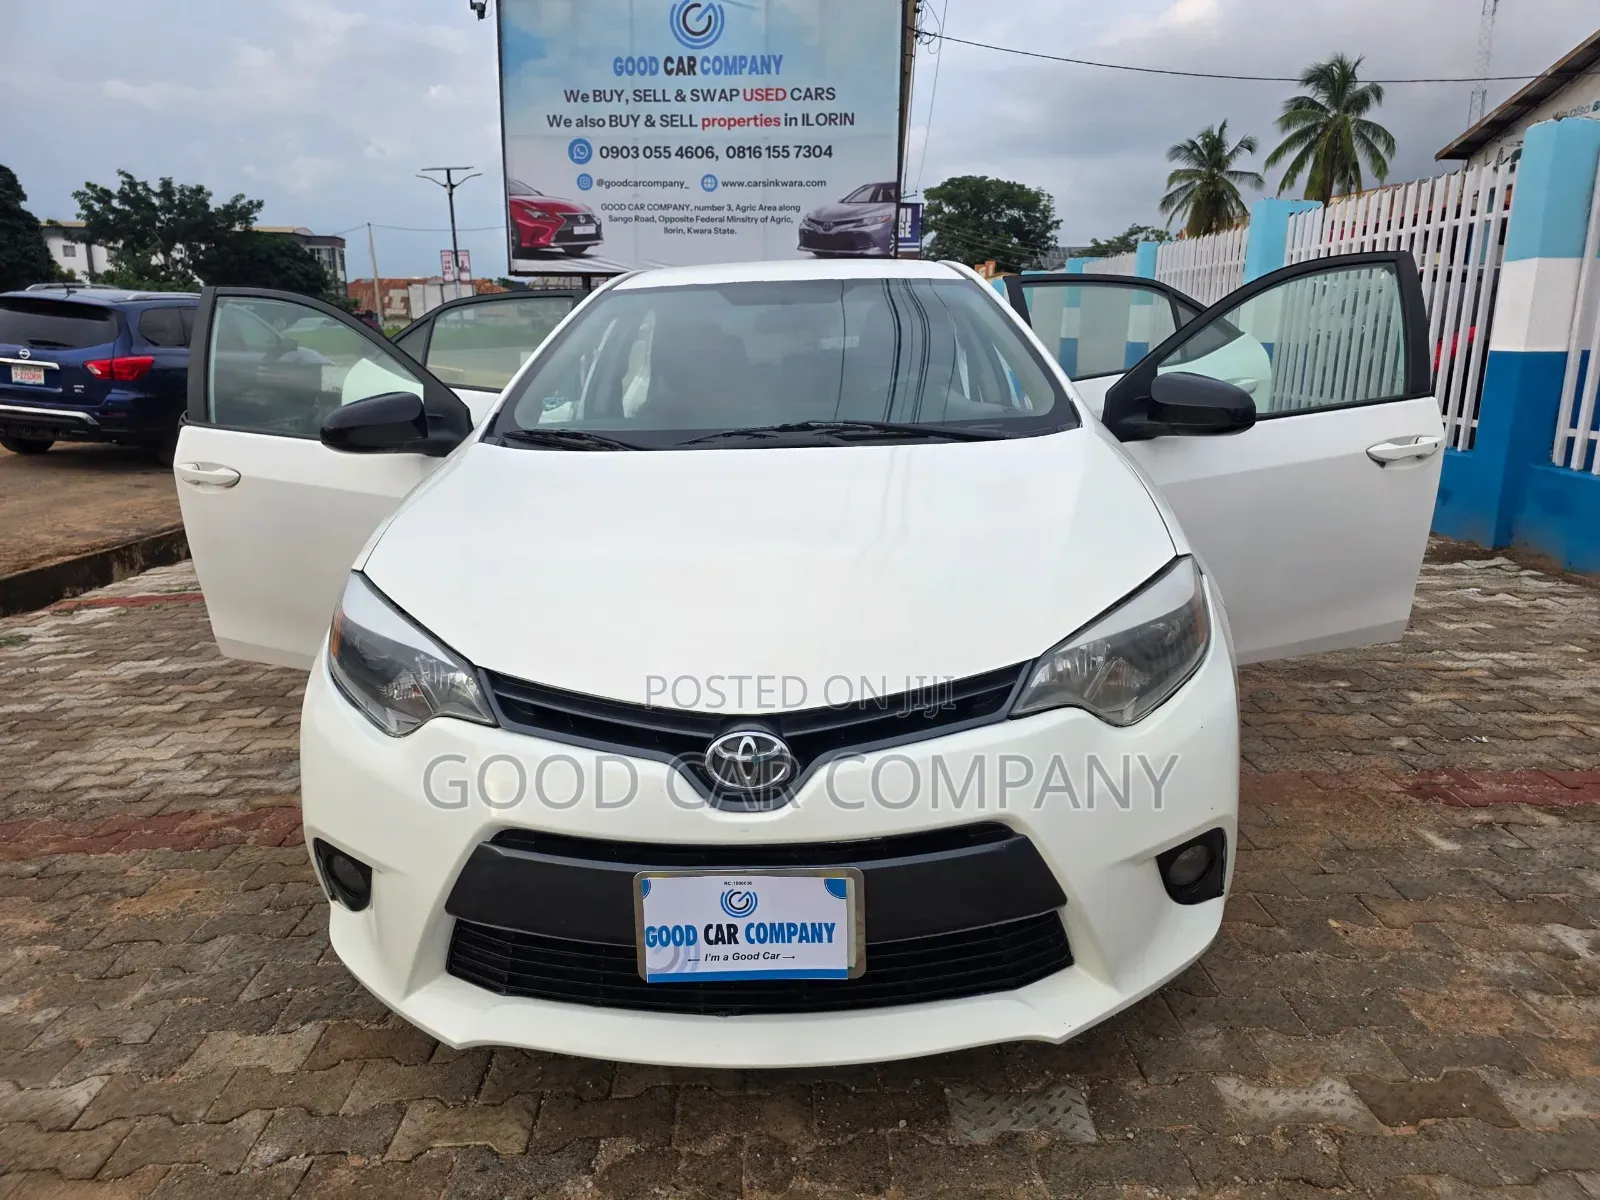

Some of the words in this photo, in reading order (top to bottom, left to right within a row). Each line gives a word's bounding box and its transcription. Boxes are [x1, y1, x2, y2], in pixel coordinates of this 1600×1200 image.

[613, 56, 659, 76] GOOD
[664, 56, 697, 76] CAR
[700, 54, 783, 75] COMPANY
[564, 89, 590, 103] We
[592, 89, 629, 105] BUY,
[632, 89, 671, 103] SELL
[674, 88, 686, 102] &
[690, 88, 740, 102] SWAP
[743, 88, 787, 101] USED
[790, 87, 836, 101] CARS
[546, 114, 573, 128] We
[575, 114, 606, 128] also
[609, 114, 640, 128] BUY
[644, 114, 656, 128] &
[659, 114, 698, 128] SELL
[701, 113, 781, 131] properties
[784, 113, 798, 127] in
[801, 112, 855, 127] ILORIN
[599, 145, 640, 160] 0903
[642, 145, 672, 160] 055
[674, 145, 719, 162] 4606,
[725, 145, 763, 159] 0816
[765, 145, 790, 159] 155
[793, 144, 833, 159] 7304
[596, 178, 690, 190] @goodcarcompany_
[721, 178, 827, 188] www.carsinkwara.com
[600, 203, 626, 211] GOOD
[628, 203, 646, 211] CAR
[647, 203, 693, 212] COMPANY,
[694, 204, 725, 212] number
[726, 204, 734, 212] 3,
[735, 204, 757, 213] Agric
[758, 204, 777, 212] Area
[778, 204, 801, 213] along
[608, 215, 634, 224] Sango
[634, 215, 657, 223] Road,
[658, 215, 694, 224] Opposite
[695, 215, 725, 223] Federal
[726, 215, 758, 225] Minsitry
[759, 215, 769, 223] of
[769, 215, 794, 225] Agric,
[663, 227, 686, 235] Ilorin,
[687, 227, 712, 235] Kwara
[713, 227, 737, 235] State.
[645, 925, 698, 948] GOOD
[703, 923, 740, 946] CAR
[744, 922, 836, 945] COMPANY
[704, 953, 720, 962] I'm
[732, 952, 760, 961] Good
[762, 952, 781, 961] Car
